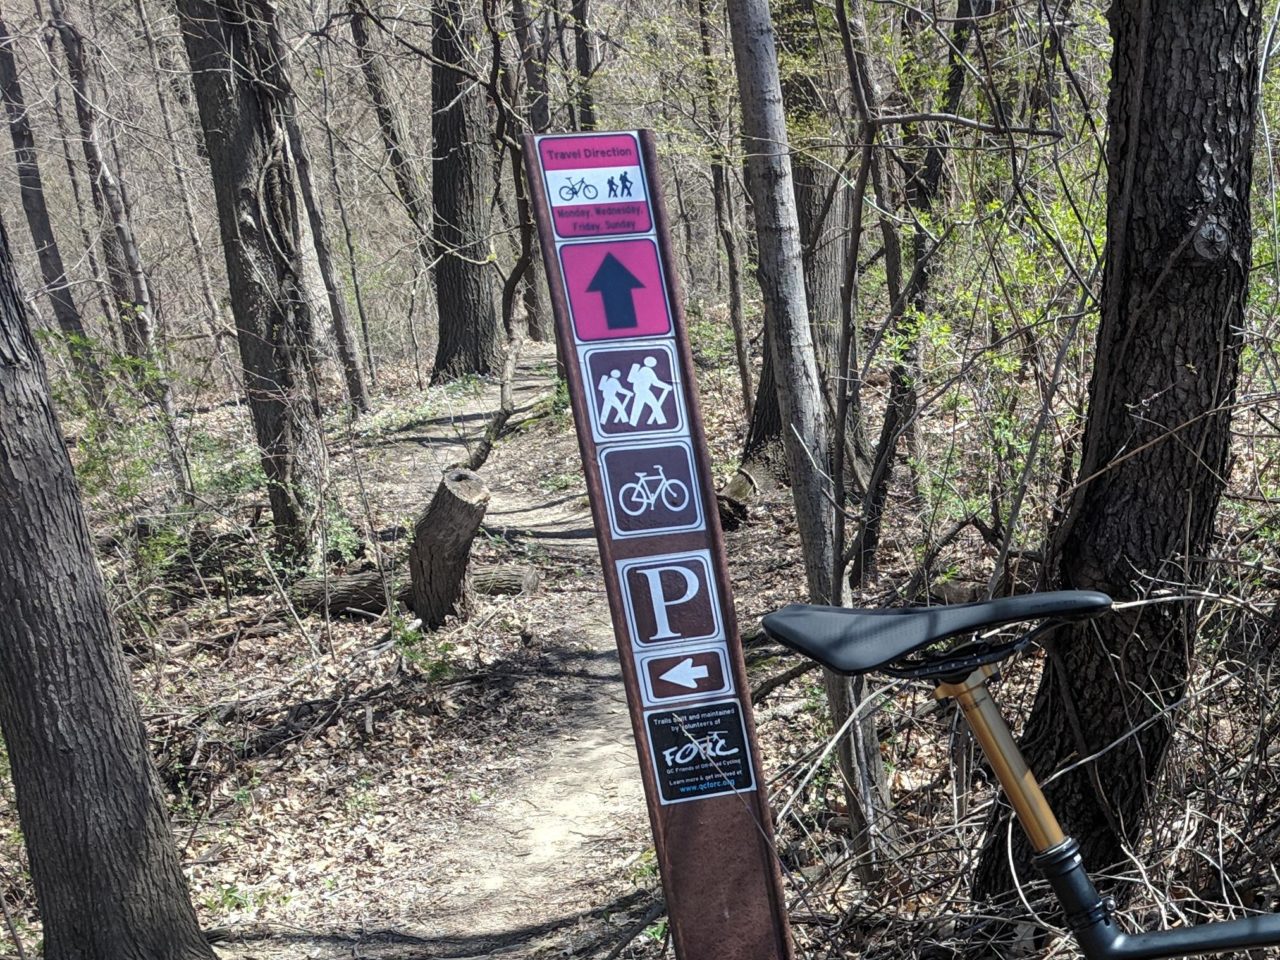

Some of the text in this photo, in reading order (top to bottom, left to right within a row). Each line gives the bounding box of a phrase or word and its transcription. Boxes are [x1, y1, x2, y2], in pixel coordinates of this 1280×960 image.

[547, 147, 631, 160] Travel Direction
[605, 219, 635, 231] Sunday
[635, 565, 700, 640] P
[653, 718, 672, 726] Trails
[701, 708, 735, 719] maintained
[662, 738, 739, 767] FORC
